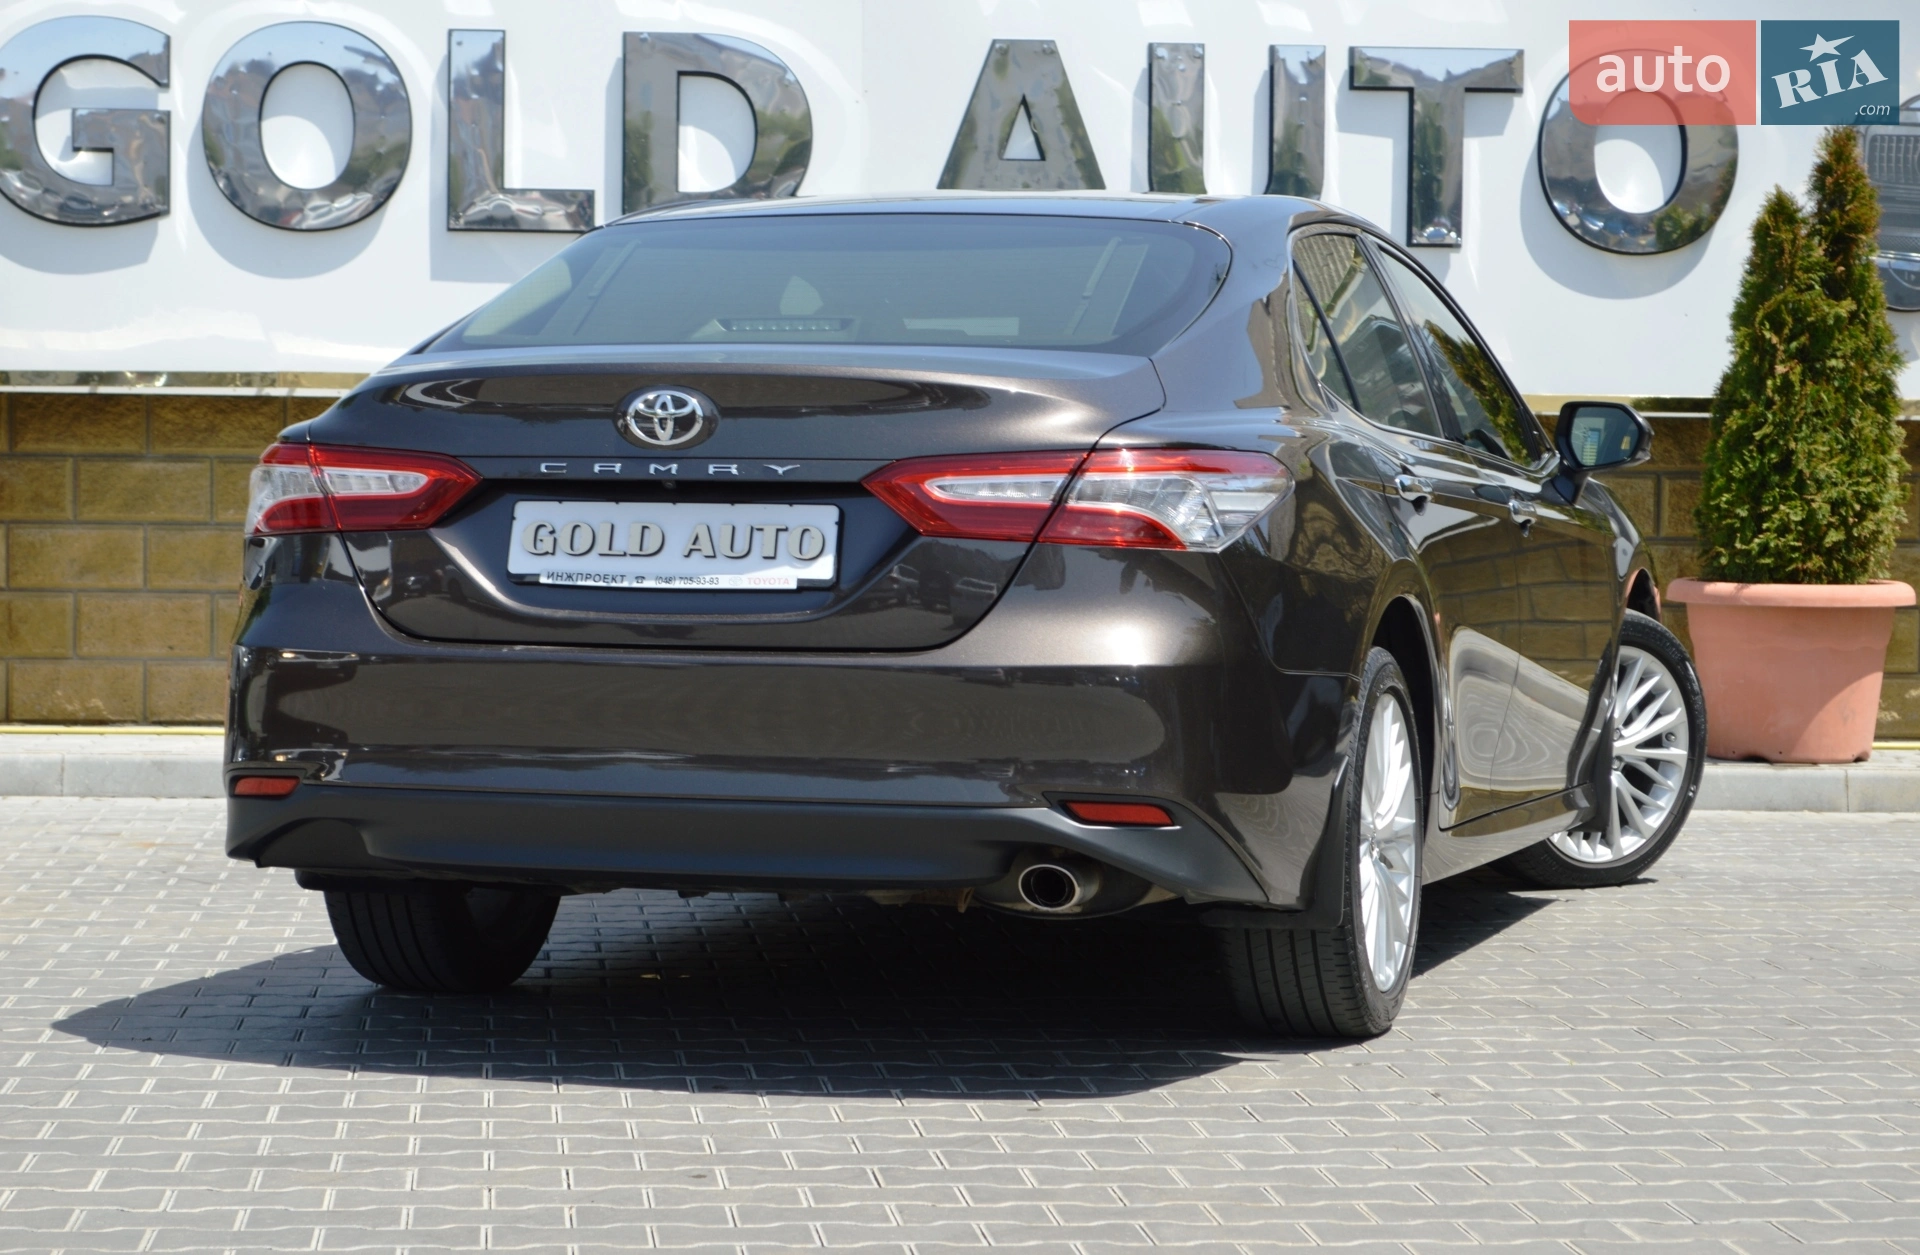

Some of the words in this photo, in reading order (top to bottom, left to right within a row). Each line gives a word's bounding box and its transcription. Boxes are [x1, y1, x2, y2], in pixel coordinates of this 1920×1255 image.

[0, 15, 813, 231] GOLD
[938, 39, 1738, 255] AUTO
[540, 463, 800, 475] CAMRY
[523, 522, 664, 557] GOLD
[684, 524, 825, 560] AUTO
[546, 571, 627, 584] ИНЖПРОЕКТ
[654, 575, 677, 586] (048)
[678, 576, 720, 586] 705-93-93
[747, 577, 790, 586] TOYOTA
